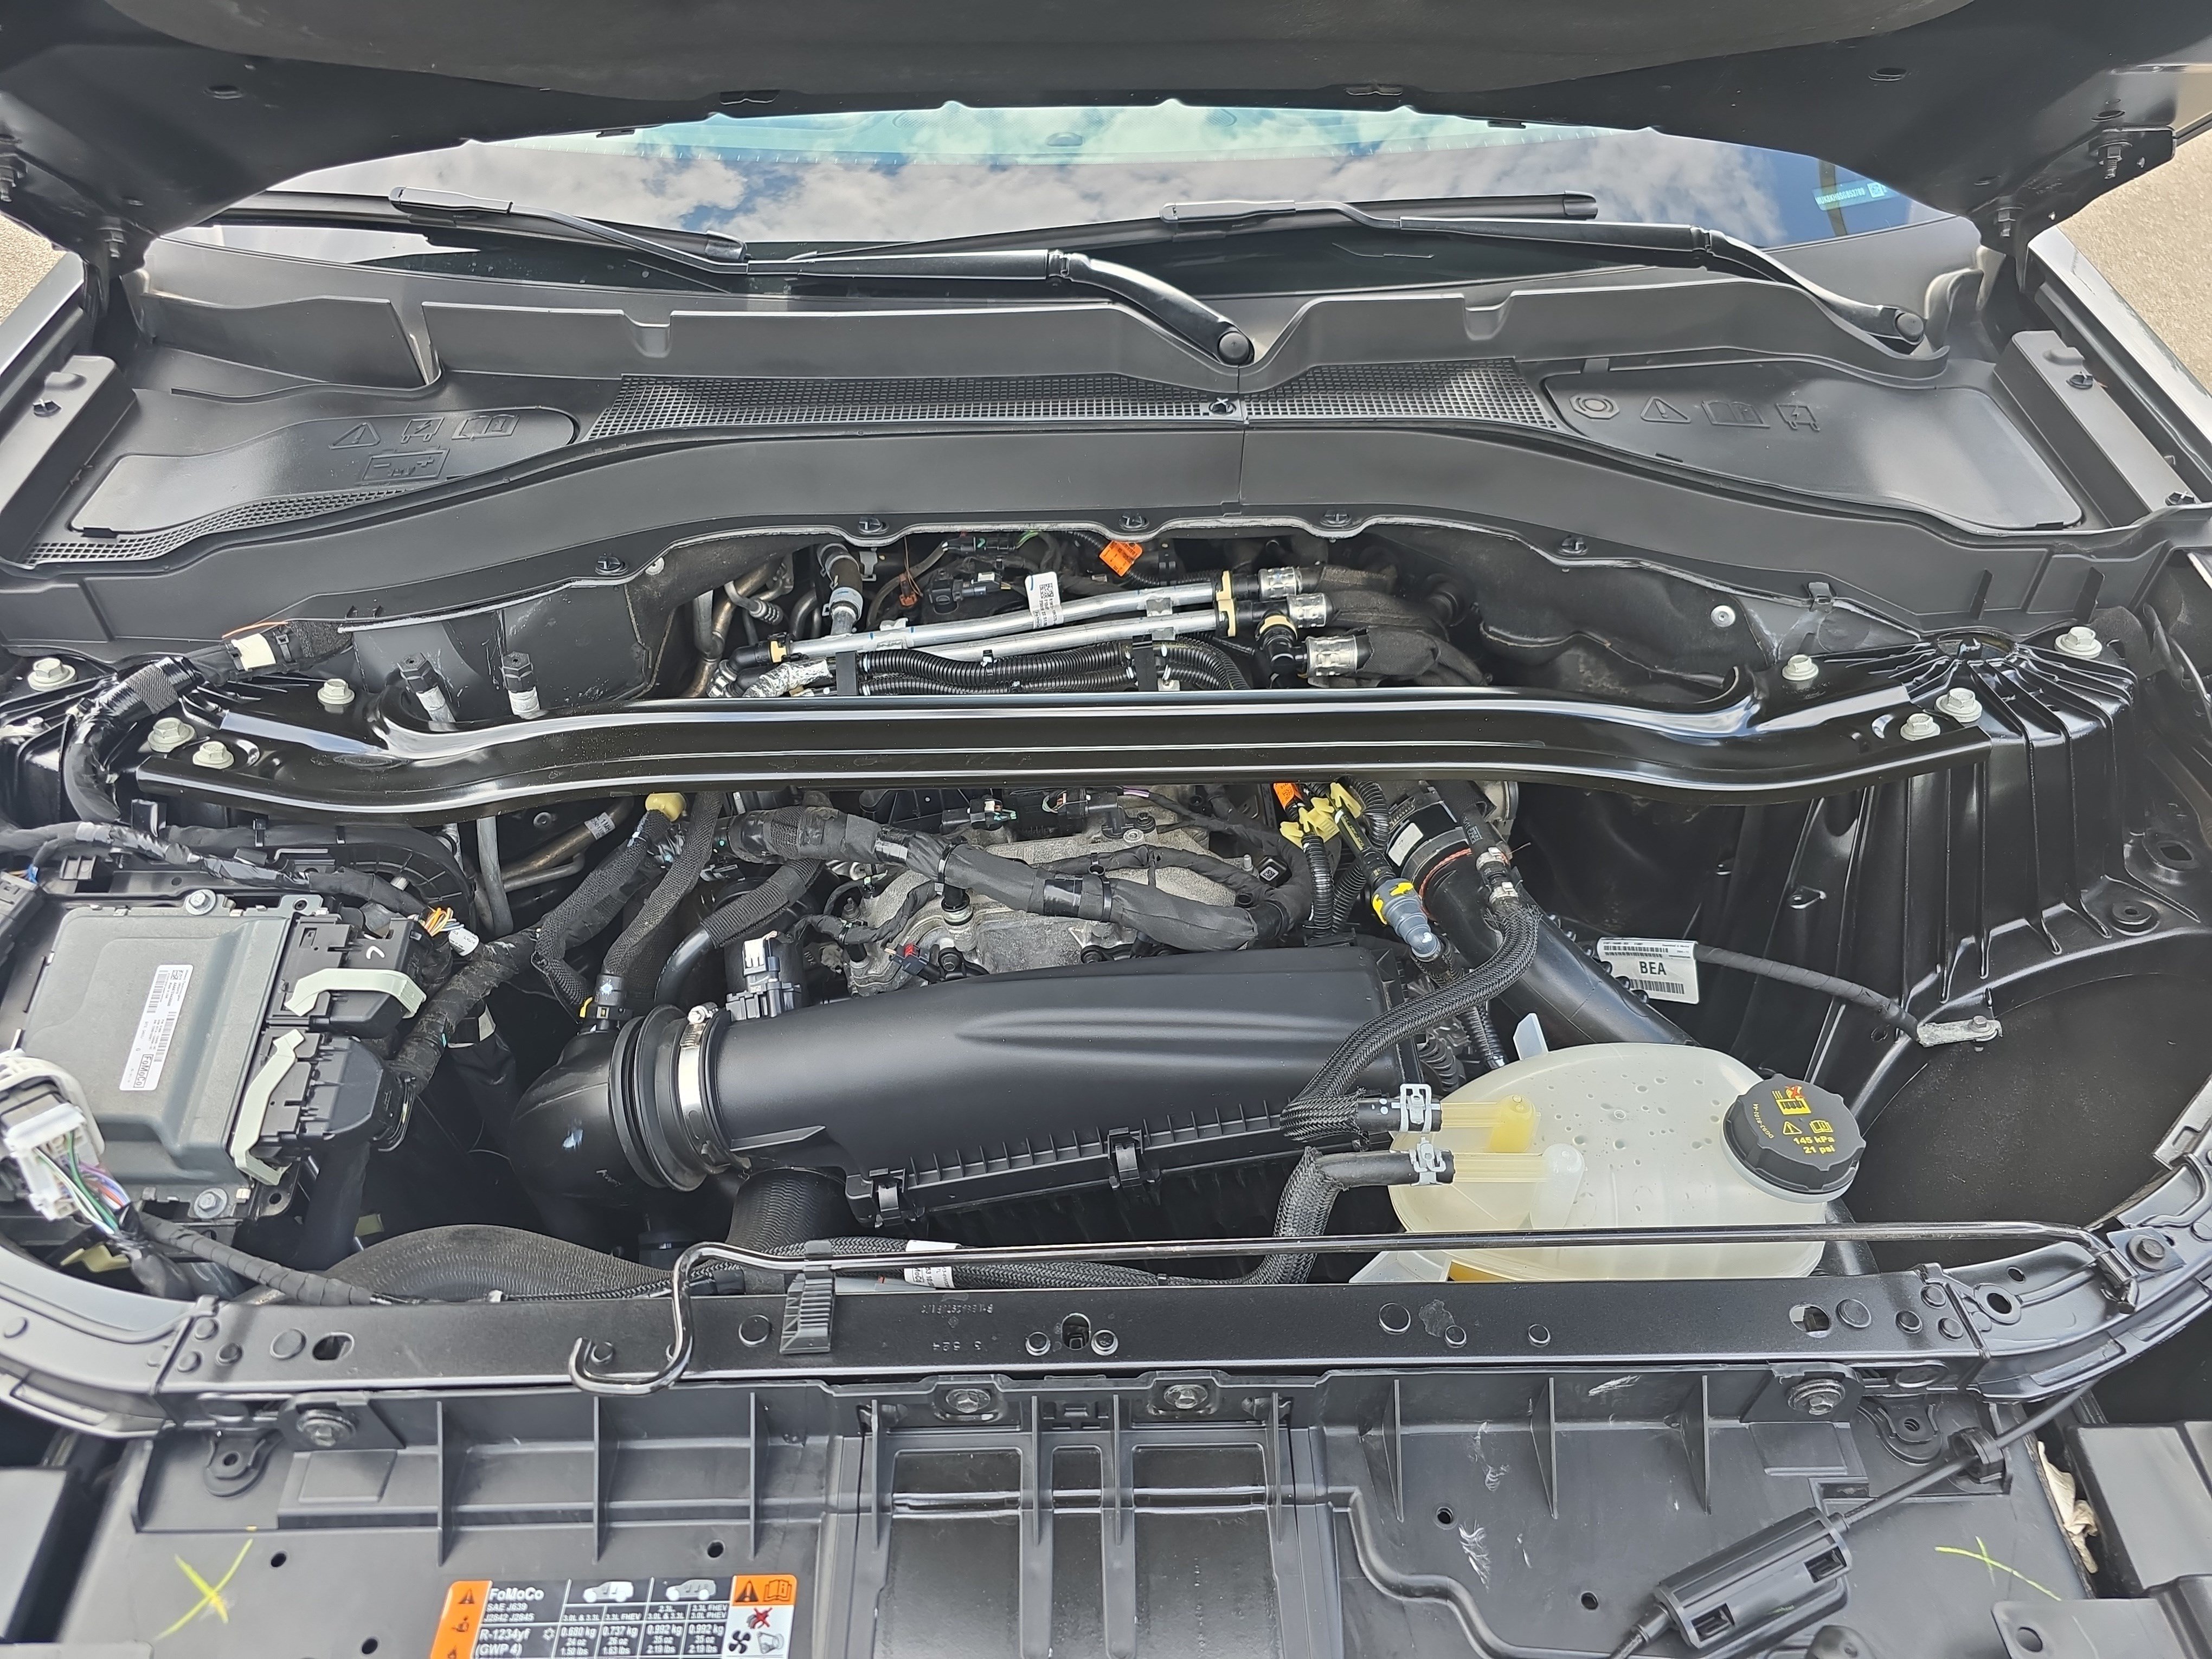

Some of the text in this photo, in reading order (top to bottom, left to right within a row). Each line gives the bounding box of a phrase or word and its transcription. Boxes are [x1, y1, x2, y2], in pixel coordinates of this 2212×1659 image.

[1639, 961, 1667, 976] BEA
[136, 1056, 152, 1086] FoMoCo
[1815, 1135, 1835, 1144] kPa
[1803, 1144, 1835, 1154] 21 psi
[489, 1587, 544, 1601] FoMoCo
[486, 1602, 528, 1612] SAE J639
[620, 1612, 642, 1621] FHEV
[561, 1626, 597, 1639] 0.680 kg
[602, 1625, 639, 1639] 0.737 kg
[646, 1624, 683, 1637] 0.992 kg
[688, 1623, 725, 1636] 0.992 kg
[479, 1628, 531, 1642] R-1234yf
[653, 1635, 663, 1644] 35
[695, 1635, 705, 1644] 35
[566, 1637, 587, 1647] 24 oz
[607, 1636, 629, 1646] 26 oz
[475, 1643, 523, 1657] (GWP 4)
[577, 1647, 589, 1656] lbs
[602, 1646, 631, 1655] 1.63 lbs
[646, 1644, 676, 1654] 2.19 lbs
[687, 1644, 718, 1654] 2.19 lbs
